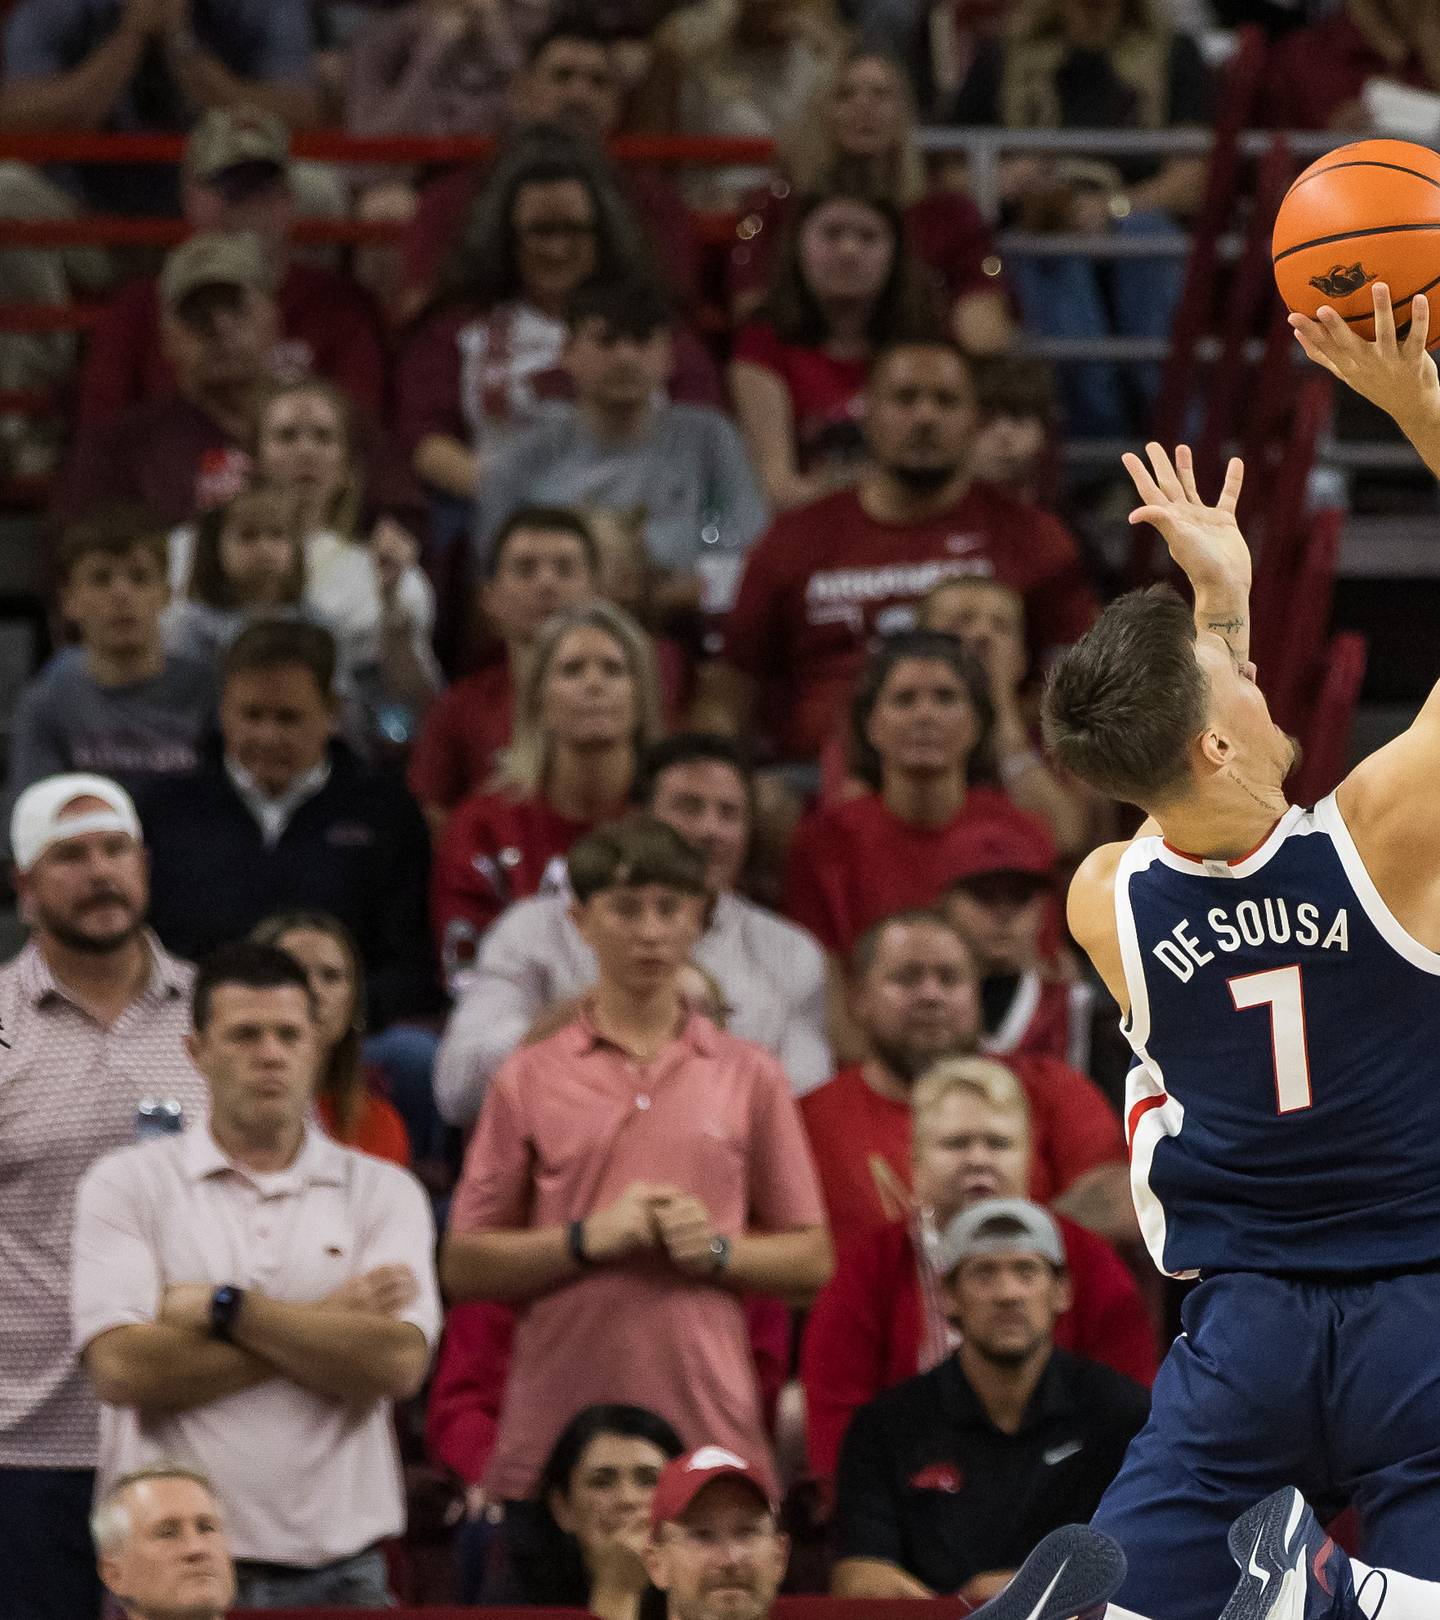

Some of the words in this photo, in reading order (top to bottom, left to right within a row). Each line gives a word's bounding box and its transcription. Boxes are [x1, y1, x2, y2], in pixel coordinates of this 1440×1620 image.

[1152, 918, 1215, 983] DE
[1207, 898, 1349, 952] SOUSA
[1226, 963, 1312, 1116] 7
